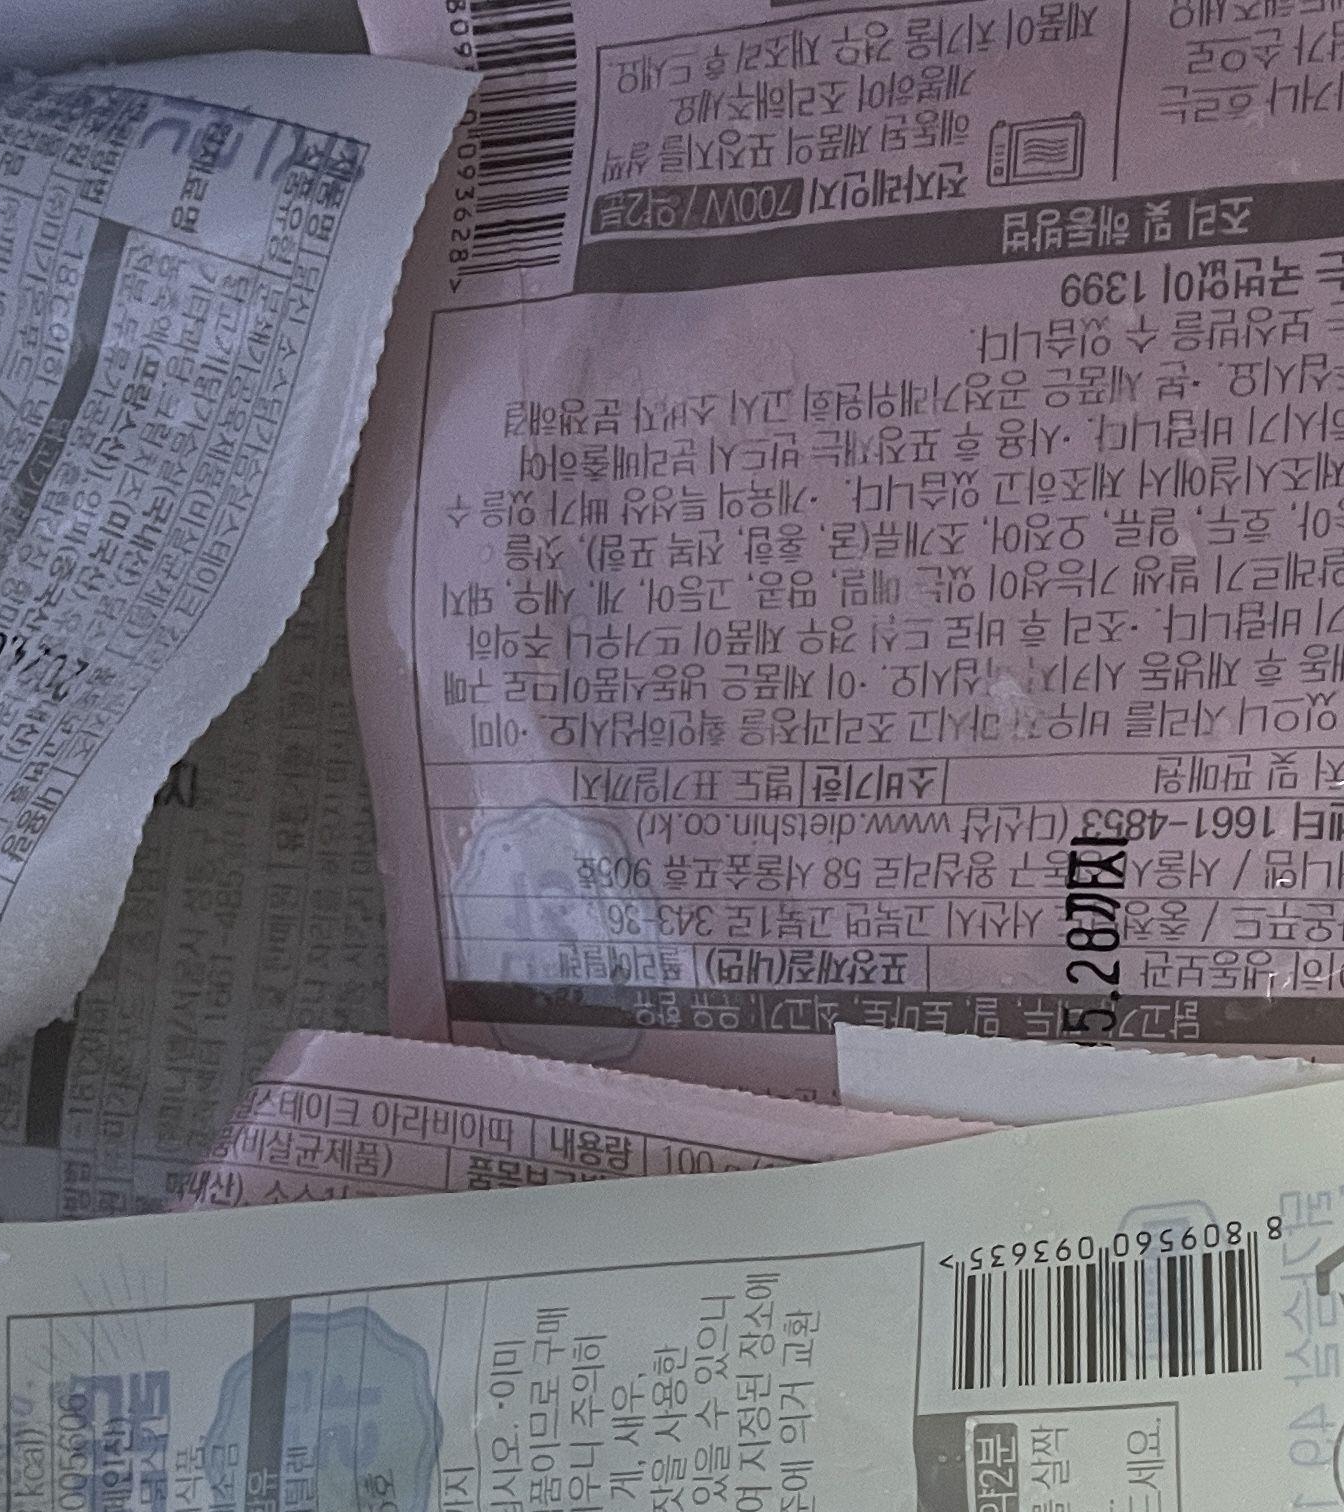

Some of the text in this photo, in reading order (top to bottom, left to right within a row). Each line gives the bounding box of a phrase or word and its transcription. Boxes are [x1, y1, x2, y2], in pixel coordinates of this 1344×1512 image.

[1002, 196, 1253, 253] 조리 및 해동방법
[1060, 270, 1145, 308] 1399
[1163, 258, 1302, 302] 국번없이
[1139, 650, 1239, 691] 재냉동
[1254, 651, 1287, 688] 후
[1125, 691, 1338, 738] 있으니 자리를
[814, 764, 935, 802] 소비기한
[1154, 753, 1252, 793] 판매원
[1267, 752, 1298, 789] 및
[824, 857, 862, 890] 58
[705, 943, 907, 984] 포장재질(내면)
[970, 1220, 1244, 1271] 809560 093635
[533, 1306, 569, 1365] 구매
[696, 1295, 741, 1385] 있으니
[738, 1272, 787, 1359] 장소에
[782, 1310, 821, 1366] 교환
[570, 1334, 607, 1427] 주의하
[652, 1347, 688, 1442] 사용한
[736, 1373, 771, 1471] 지정된
[778, 1380, 814, 1444] 의거
[1031, 1427, 1071, 1487] 살짝
